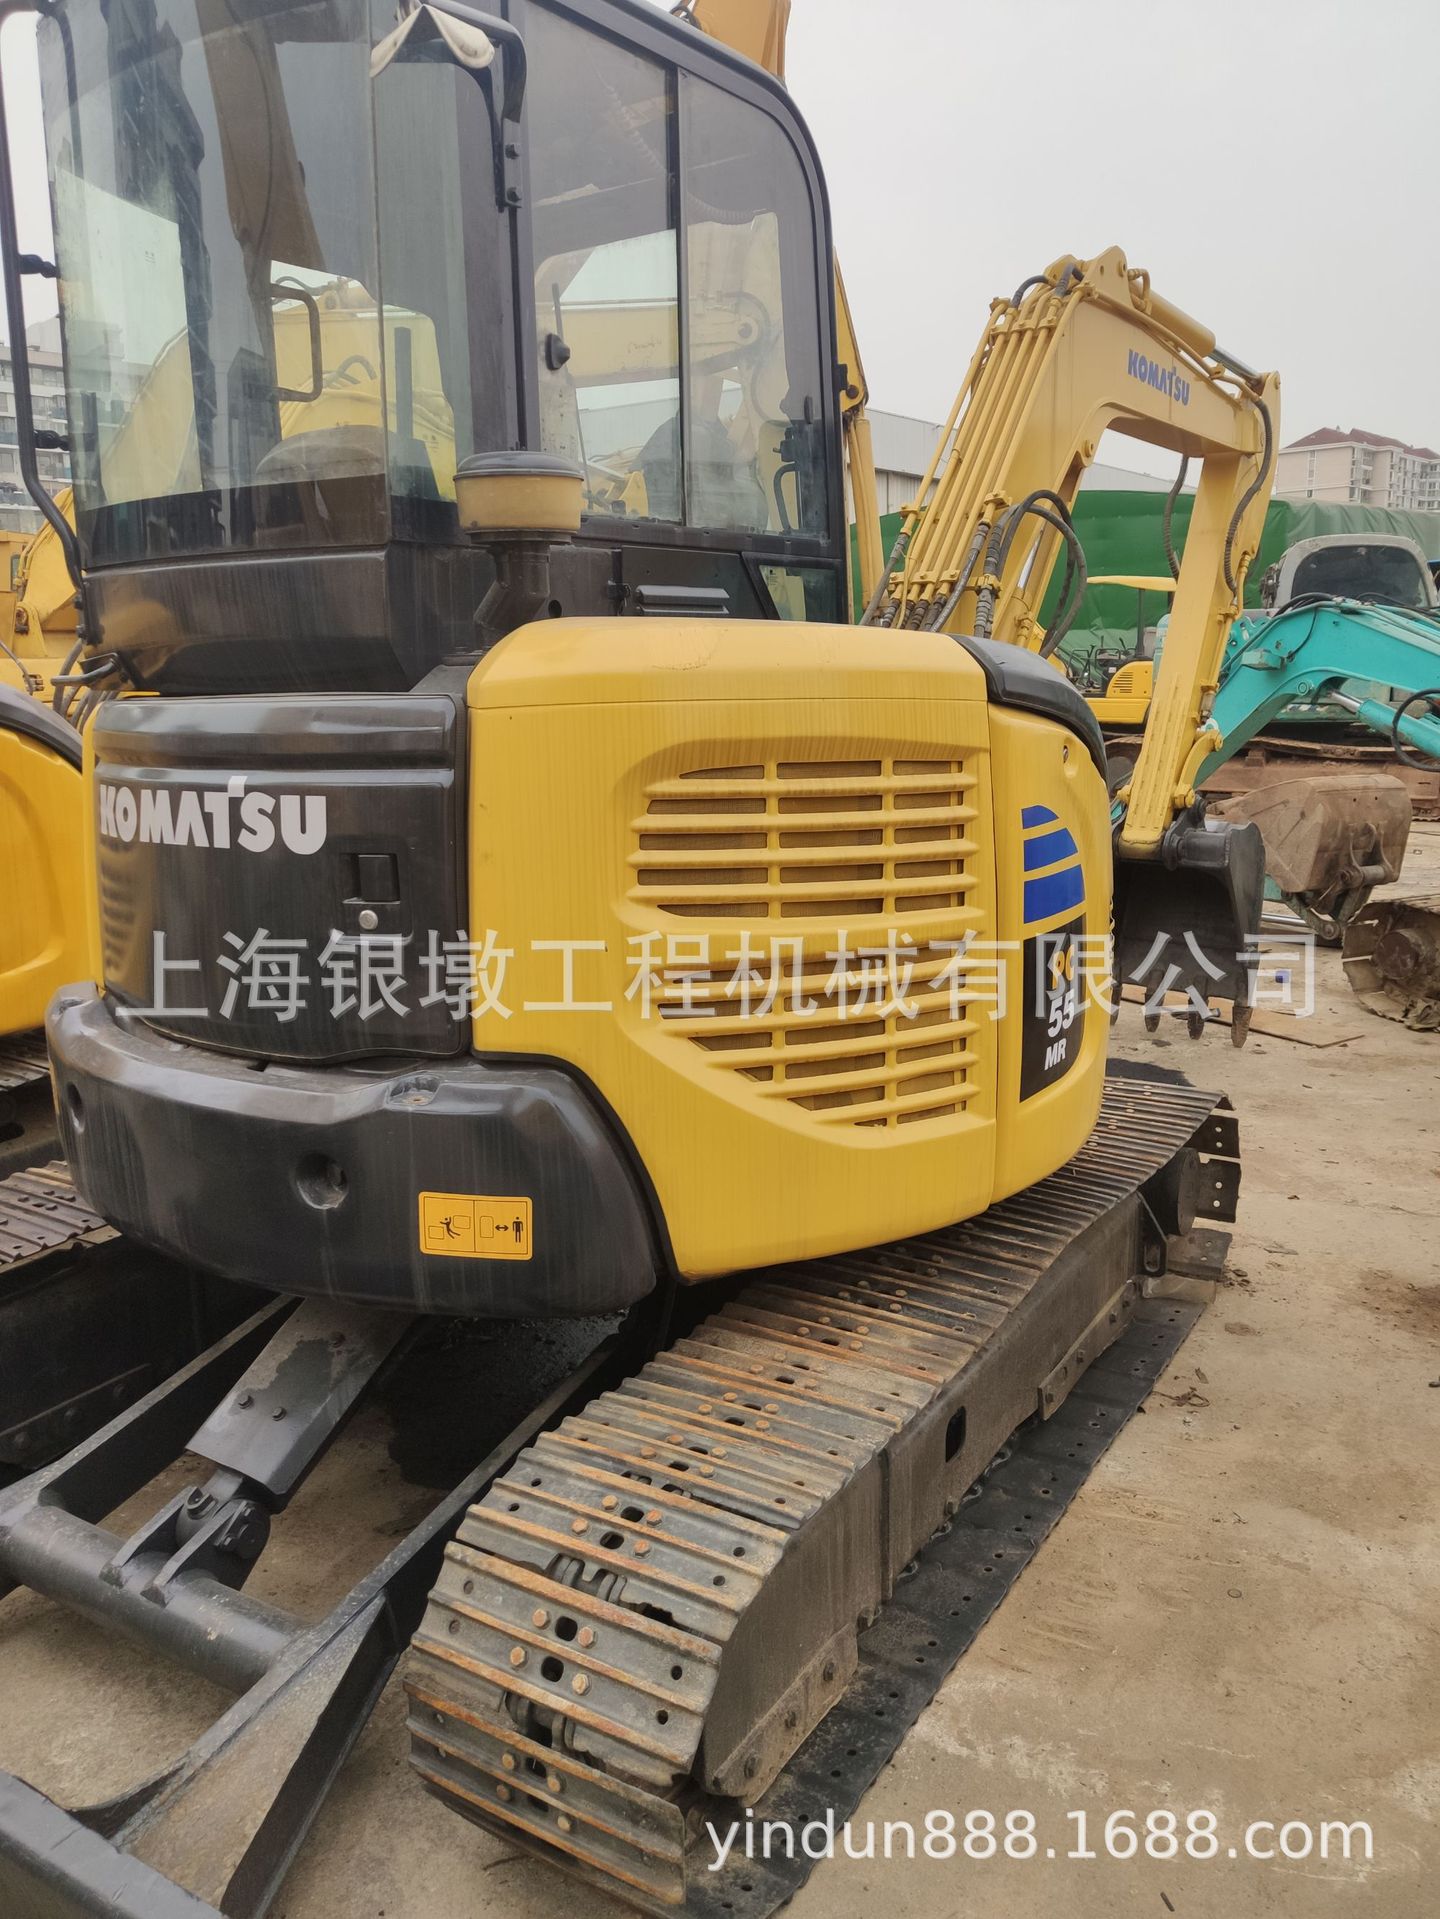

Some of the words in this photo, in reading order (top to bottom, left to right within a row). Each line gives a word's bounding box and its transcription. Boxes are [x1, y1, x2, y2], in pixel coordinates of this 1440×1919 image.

[1127, 347, 1191, 407] KOMATSU
[99, 775, 328, 856] KOMATSU
[1048, 988, 1075, 1037] 55
[1044, 1038, 1067, 1070] MR
